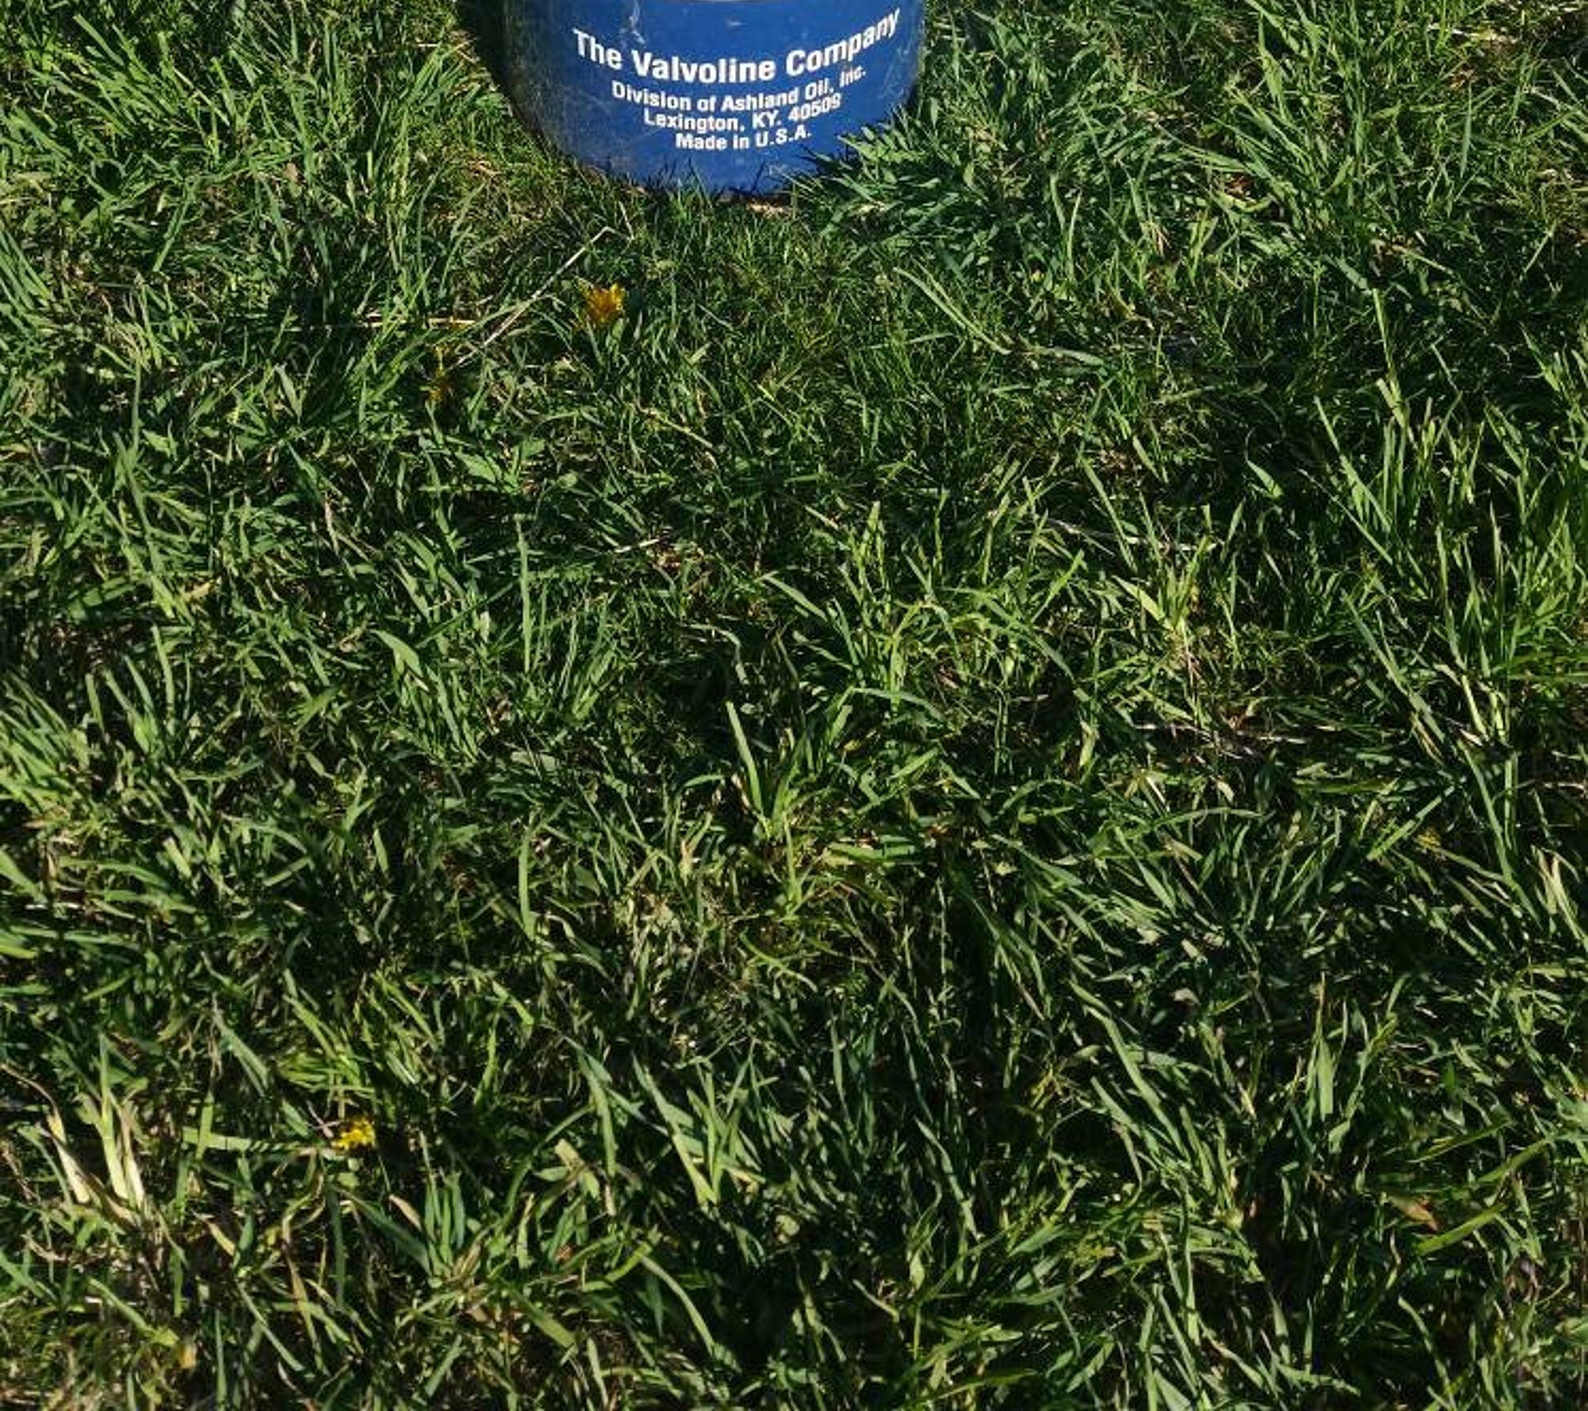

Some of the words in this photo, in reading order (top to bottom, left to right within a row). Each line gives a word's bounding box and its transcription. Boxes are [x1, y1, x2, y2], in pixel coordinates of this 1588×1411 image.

[572, 28, 623, 71] The
[631, 49, 776, 84] Valvoline
[786, 8, 900, 76] Company
[611, 80, 692, 111] Division
[697, 96, 717, 112] of
[720, 89, 799, 113] Ashland
[643, 108, 745, 134] Lexington,
[751, 109, 782, 129] KY.
[787, 92, 843, 123] 40509
[675, 132, 728, 151] Made
[733, 132, 750, 150] in
[755, 124, 812, 147] U.S.A.
